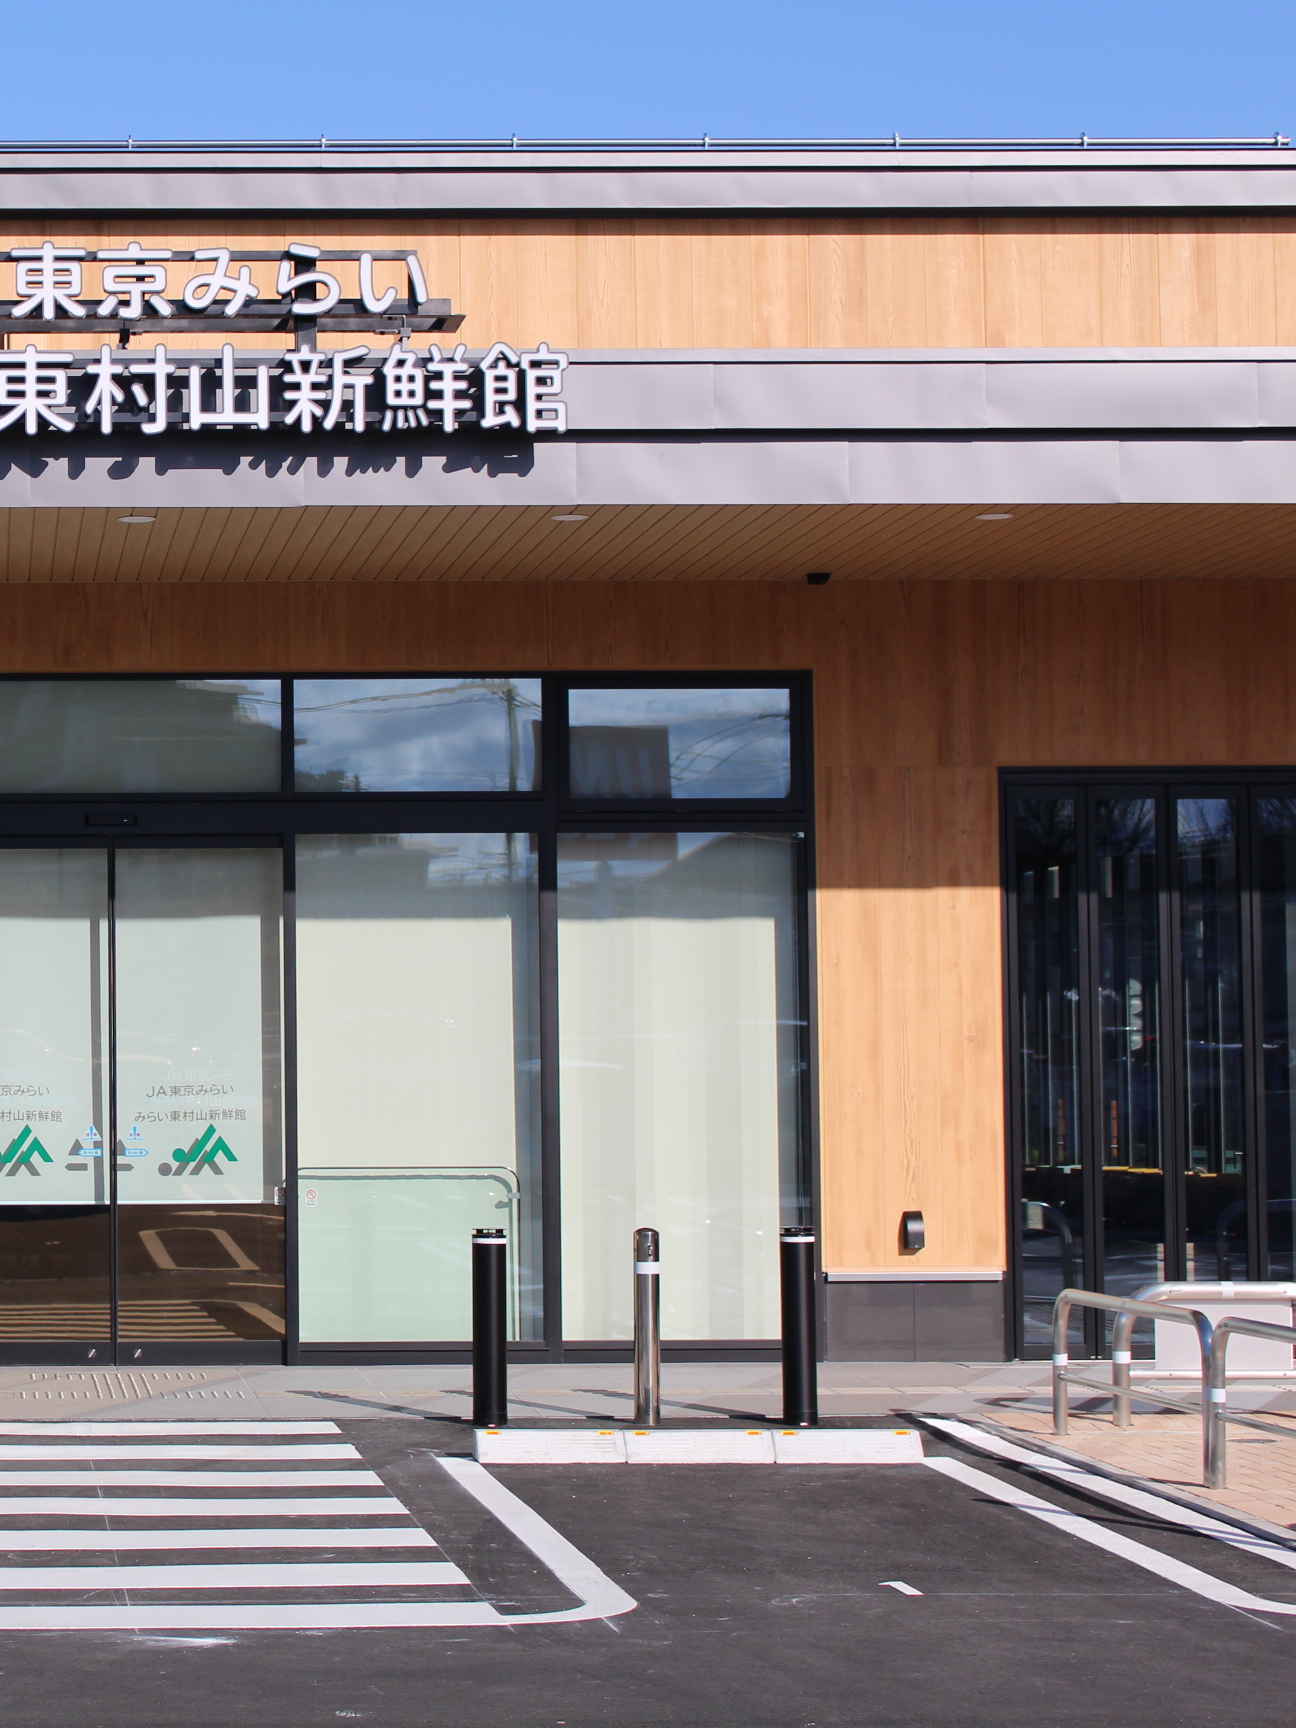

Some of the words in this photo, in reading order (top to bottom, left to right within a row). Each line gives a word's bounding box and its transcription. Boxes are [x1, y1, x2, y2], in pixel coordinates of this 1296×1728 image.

[146, 1083, 234, 1098] JA東京みらい
[134, 1108, 247, 1122] みらい東村山新鮮館
